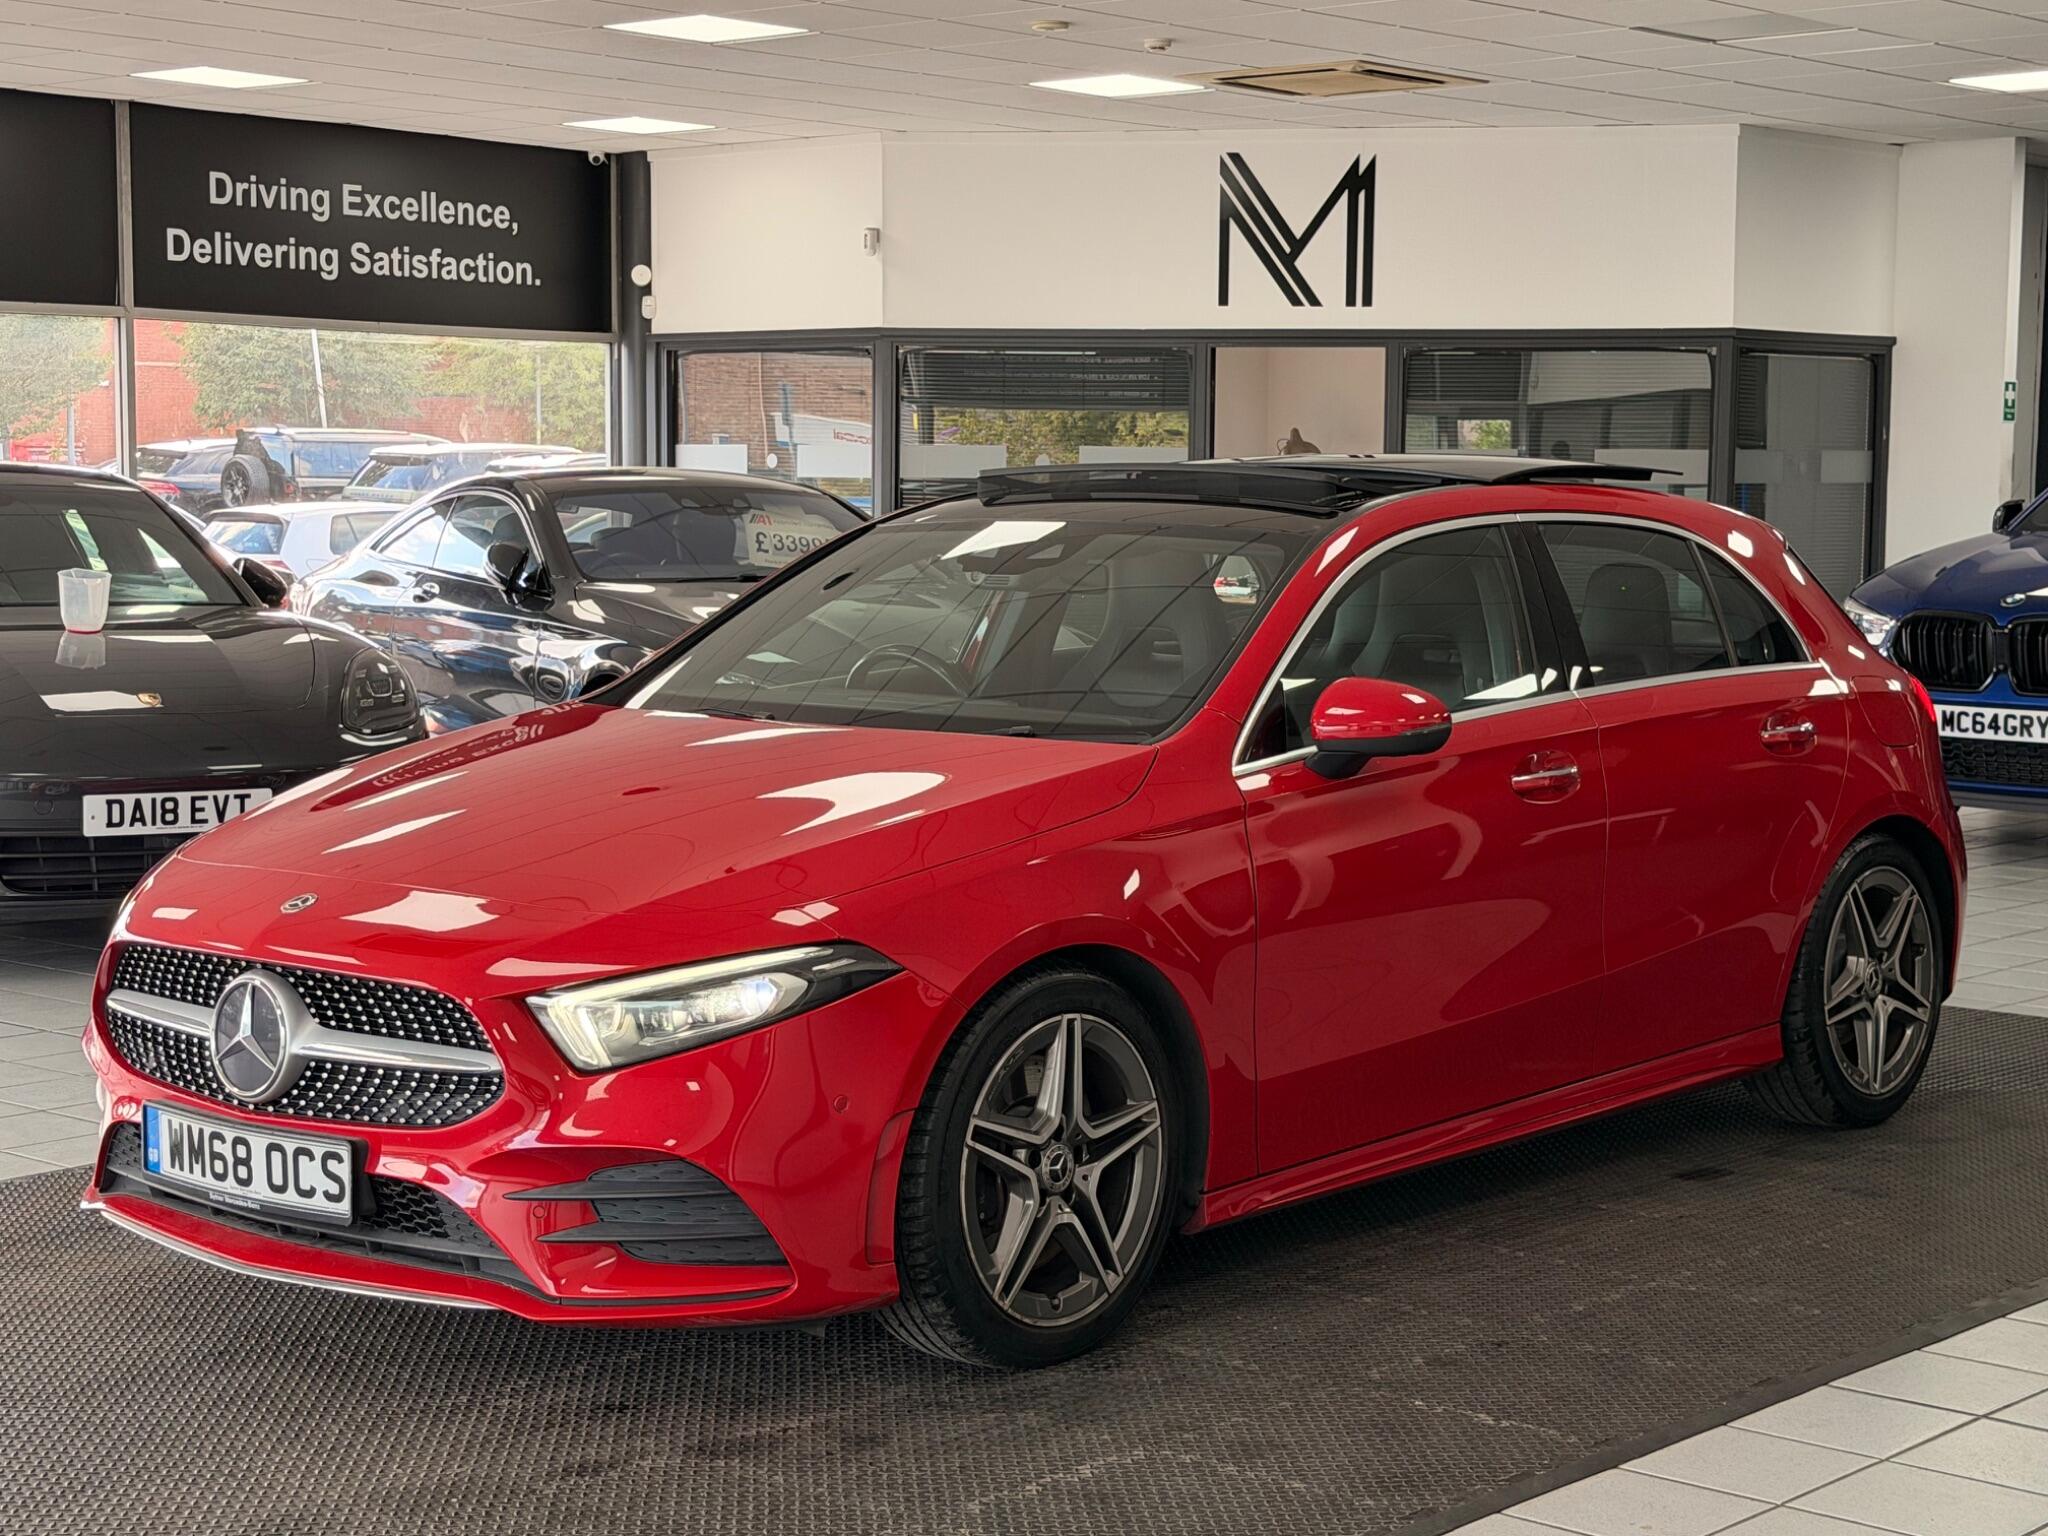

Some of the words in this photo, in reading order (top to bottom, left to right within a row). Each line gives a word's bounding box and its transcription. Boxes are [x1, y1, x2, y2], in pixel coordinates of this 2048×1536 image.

[209, 171, 330, 222] Driving
[342, 183, 518, 235] Excellence,
[166, 227, 339, 281] Delivering
[350, 241, 541, 286] Satisfaction.
[1941, 709, 2048, 738] MC64GRY
[105, 797, 179, 828] DA18
[190, 793, 252, 824] EVT
[168, 1119, 254, 1188] WM68
[265, 1142, 346, 1204] OCS
